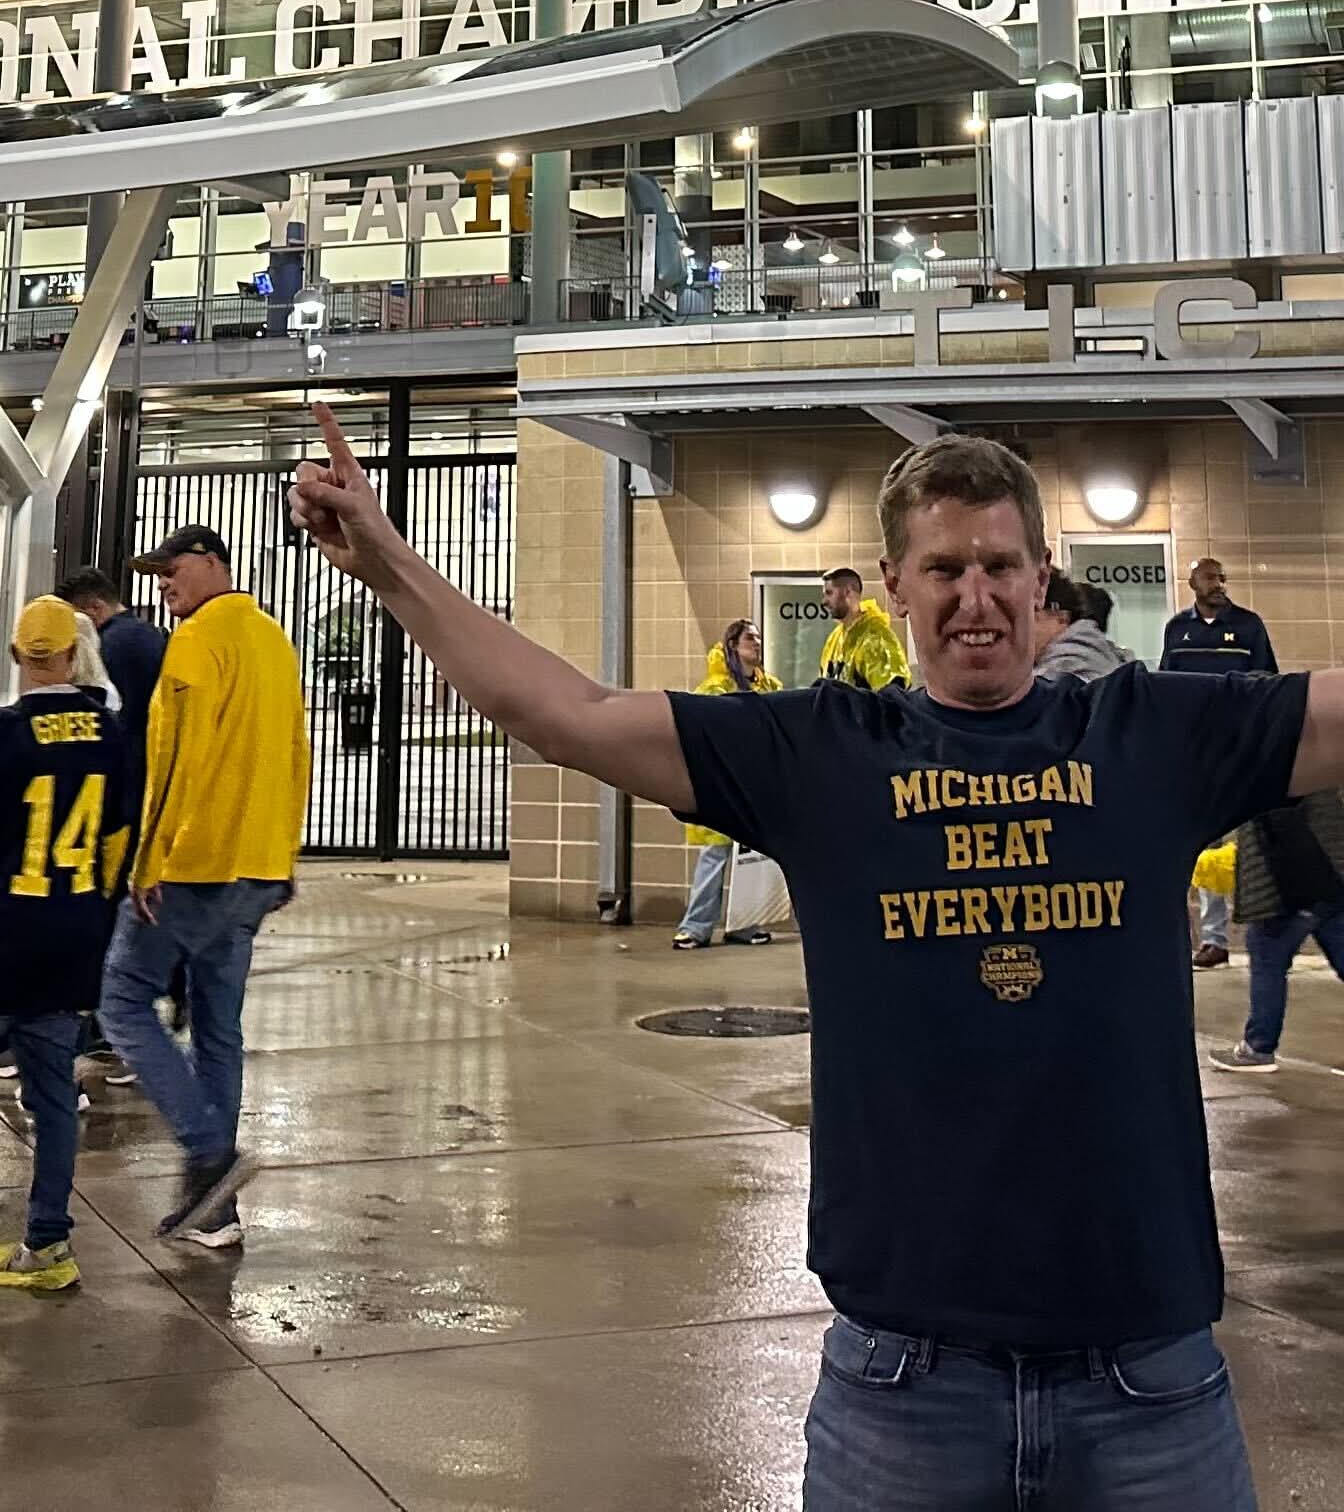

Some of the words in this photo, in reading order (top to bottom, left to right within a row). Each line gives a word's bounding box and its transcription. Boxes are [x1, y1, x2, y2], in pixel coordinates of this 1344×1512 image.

[262, 170, 460, 248] YEAR
[1085, 565, 1166, 584] CLOSED
[779, 601, 831, 620] CLOS
[890, 760, 1096, 819] MICHIGAN
[8, 774, 106, 898] 14
[944, 818, 1053, 870] BEAT
[879, 880, 1125, 940] EVERYBODY
